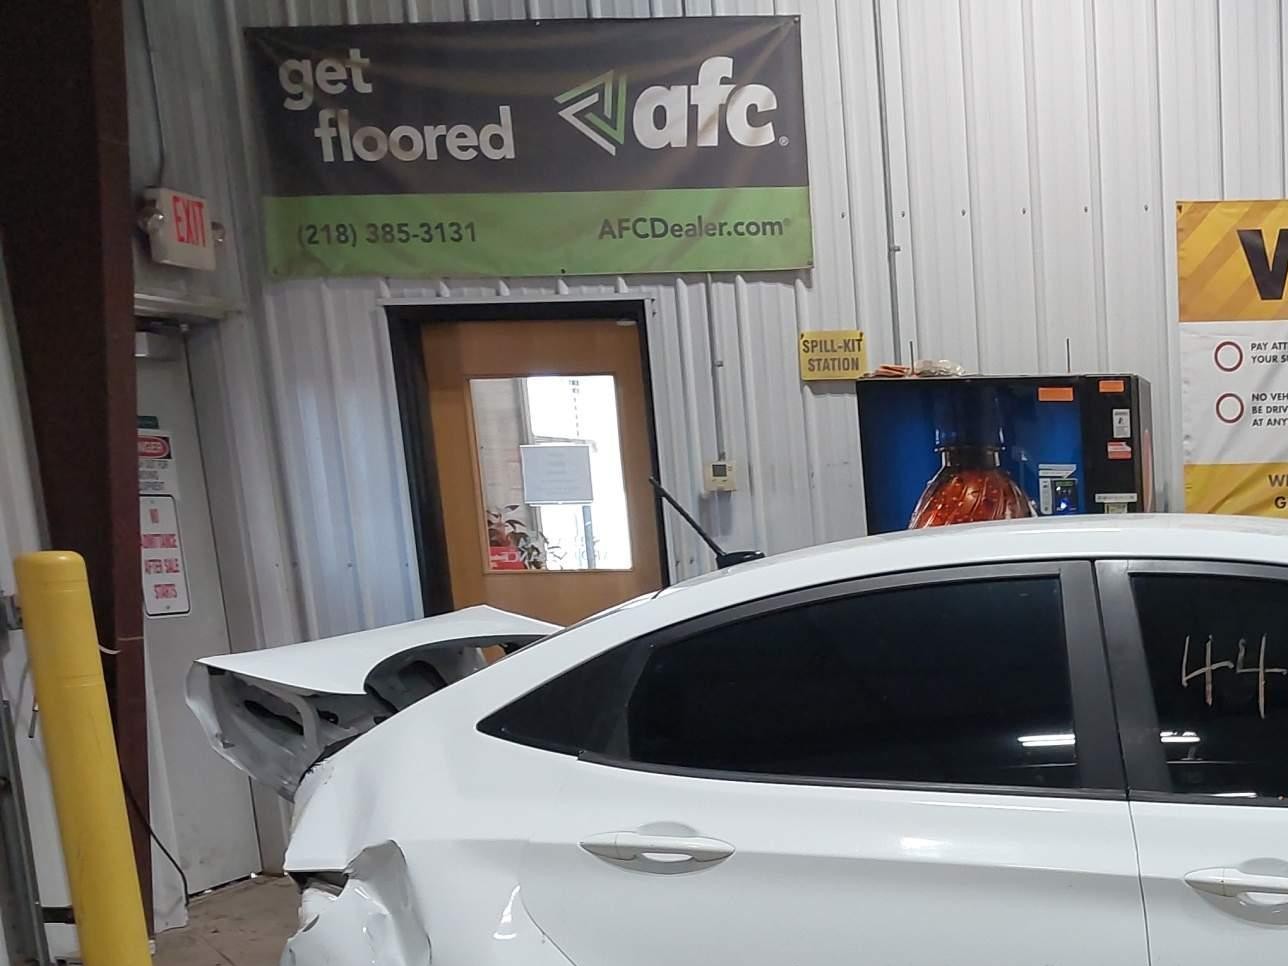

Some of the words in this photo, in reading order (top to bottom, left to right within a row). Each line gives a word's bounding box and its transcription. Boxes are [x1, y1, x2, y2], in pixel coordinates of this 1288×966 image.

[278, 48, 373, 111] get
[314, 105, 515, 162] floored
[172, 195, 206, 247] EXIT
[598, 215, 783, 239] AFCDealer.com
[297, 224, 357, 248] (218)
[365, 221, 476, 244] 385-3131
[802, 339, 863, 353] SPILL-KIT
[1251, 341, 1268, 351] PAY
[808, 357, 859, 372] STATION
[1251, 354, 1278, 364] YOUR
[1252, 392, 1267, 402] NO
[1252, 405, 1263, 415] BE
[1252, 417, 1264, 427] AT
